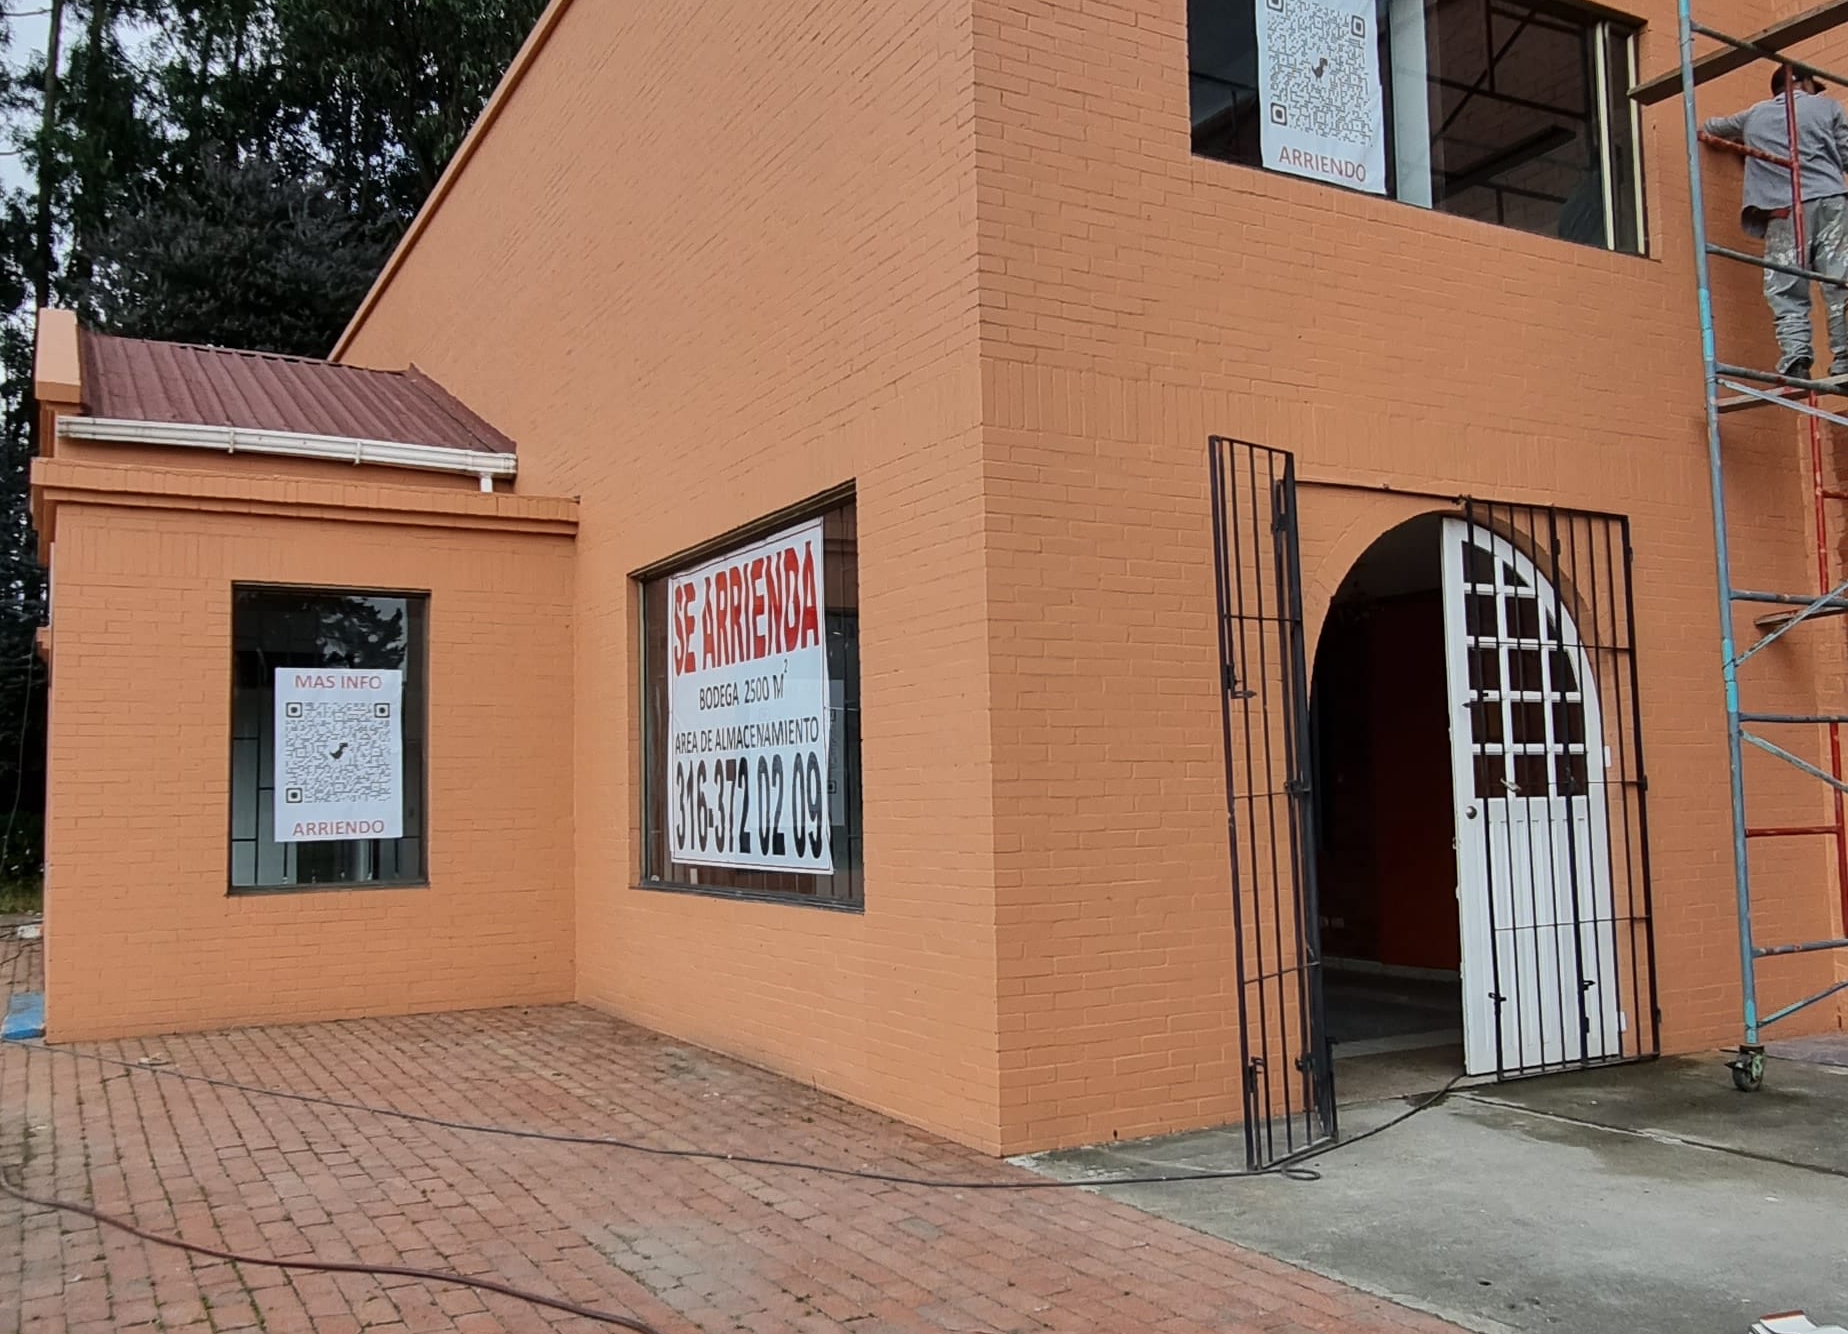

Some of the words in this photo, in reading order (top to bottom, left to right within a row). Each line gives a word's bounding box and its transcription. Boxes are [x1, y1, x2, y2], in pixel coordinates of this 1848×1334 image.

[1278, 146, 1367, 183] ARRIENDO
[674, 582, 697, 677] SE
[702, 540, 820, 670] ARRIENDA
[294, 675, 336, 690] MAS
[341, 675, 383, 691] INFO
[699, 682, 740, 711] BODEGA
[744, 676, 770, 703] 2500
[675, 731, 699, 755] AREA
[700, 729, 713, 752] DE
[714, 716, 820, 751] ALMACENAMIENTO
[676, 757, 752, 854] 316-372
[757, 754, 786, 857] 02
[792, 751, 823, 860] 09
[293, 819, 385, 836] ARRIENDO
